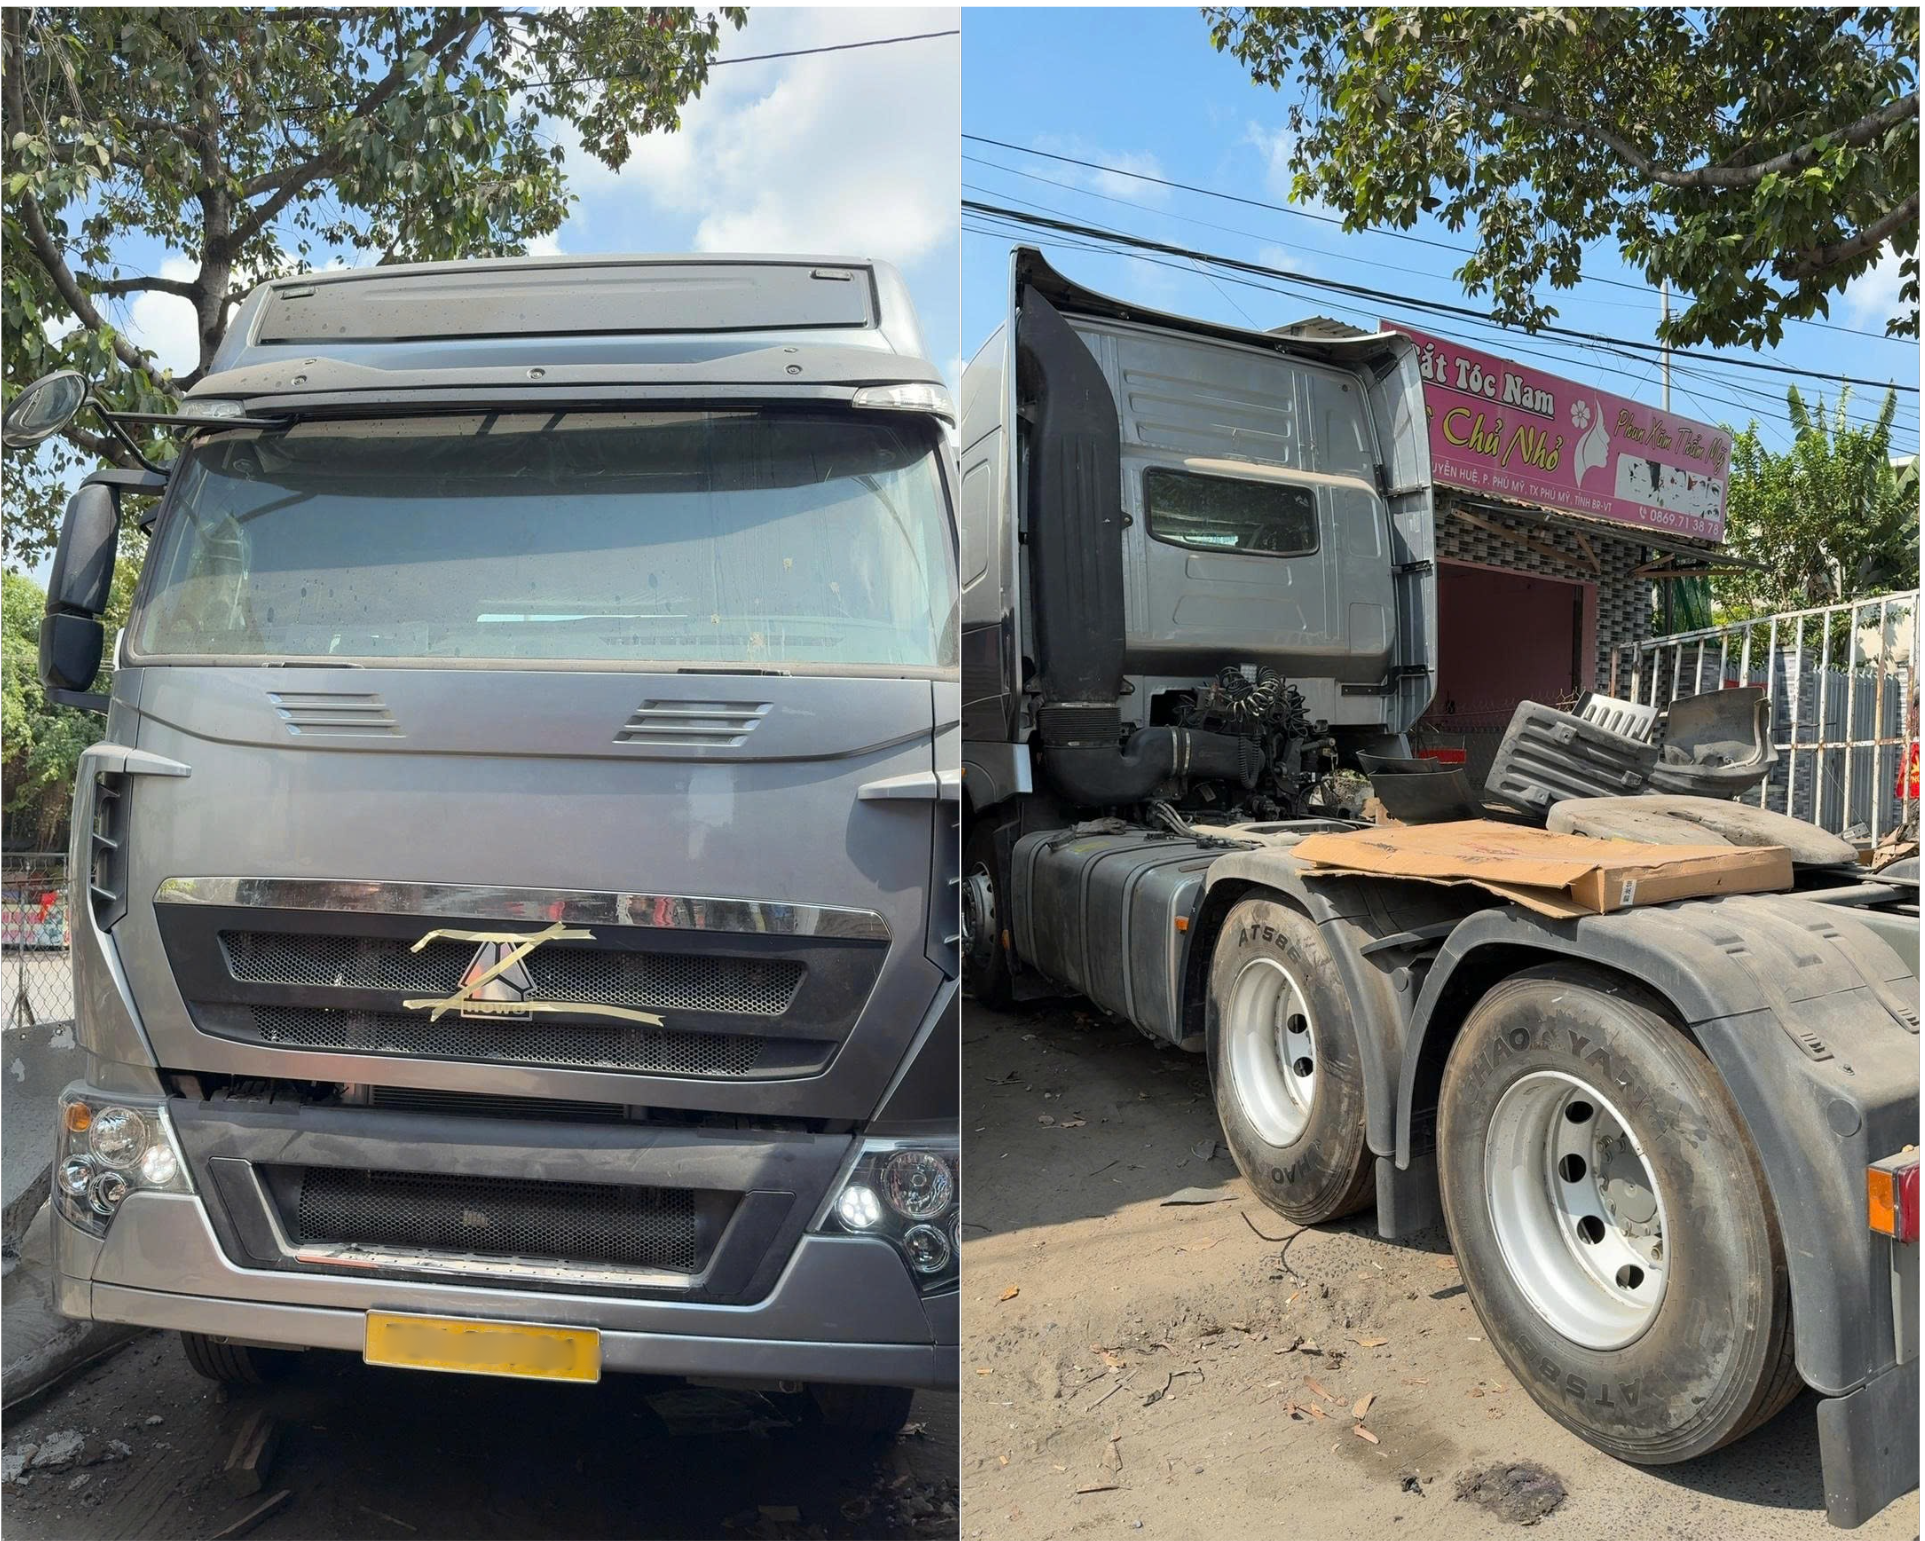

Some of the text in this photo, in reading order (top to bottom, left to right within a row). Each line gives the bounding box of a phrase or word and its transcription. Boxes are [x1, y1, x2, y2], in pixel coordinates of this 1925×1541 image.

[1414, 342, 1555, 415] ắt Tóc Nam
[1442, 406, 1503, 457] Chủ
[1500, 424, 1563, 472] Nhỏ
[1645, 417, 1672, 451] Xăm
[1483, 474, 1490, 485] P.
[1493, 476, 1509, 490] PHÚ
[1529, 484, 1538, 496] TX
[1592, 499, 1612, 512] BR-VT
[1650, 510, 1719, 536] 0869.71 38 78
